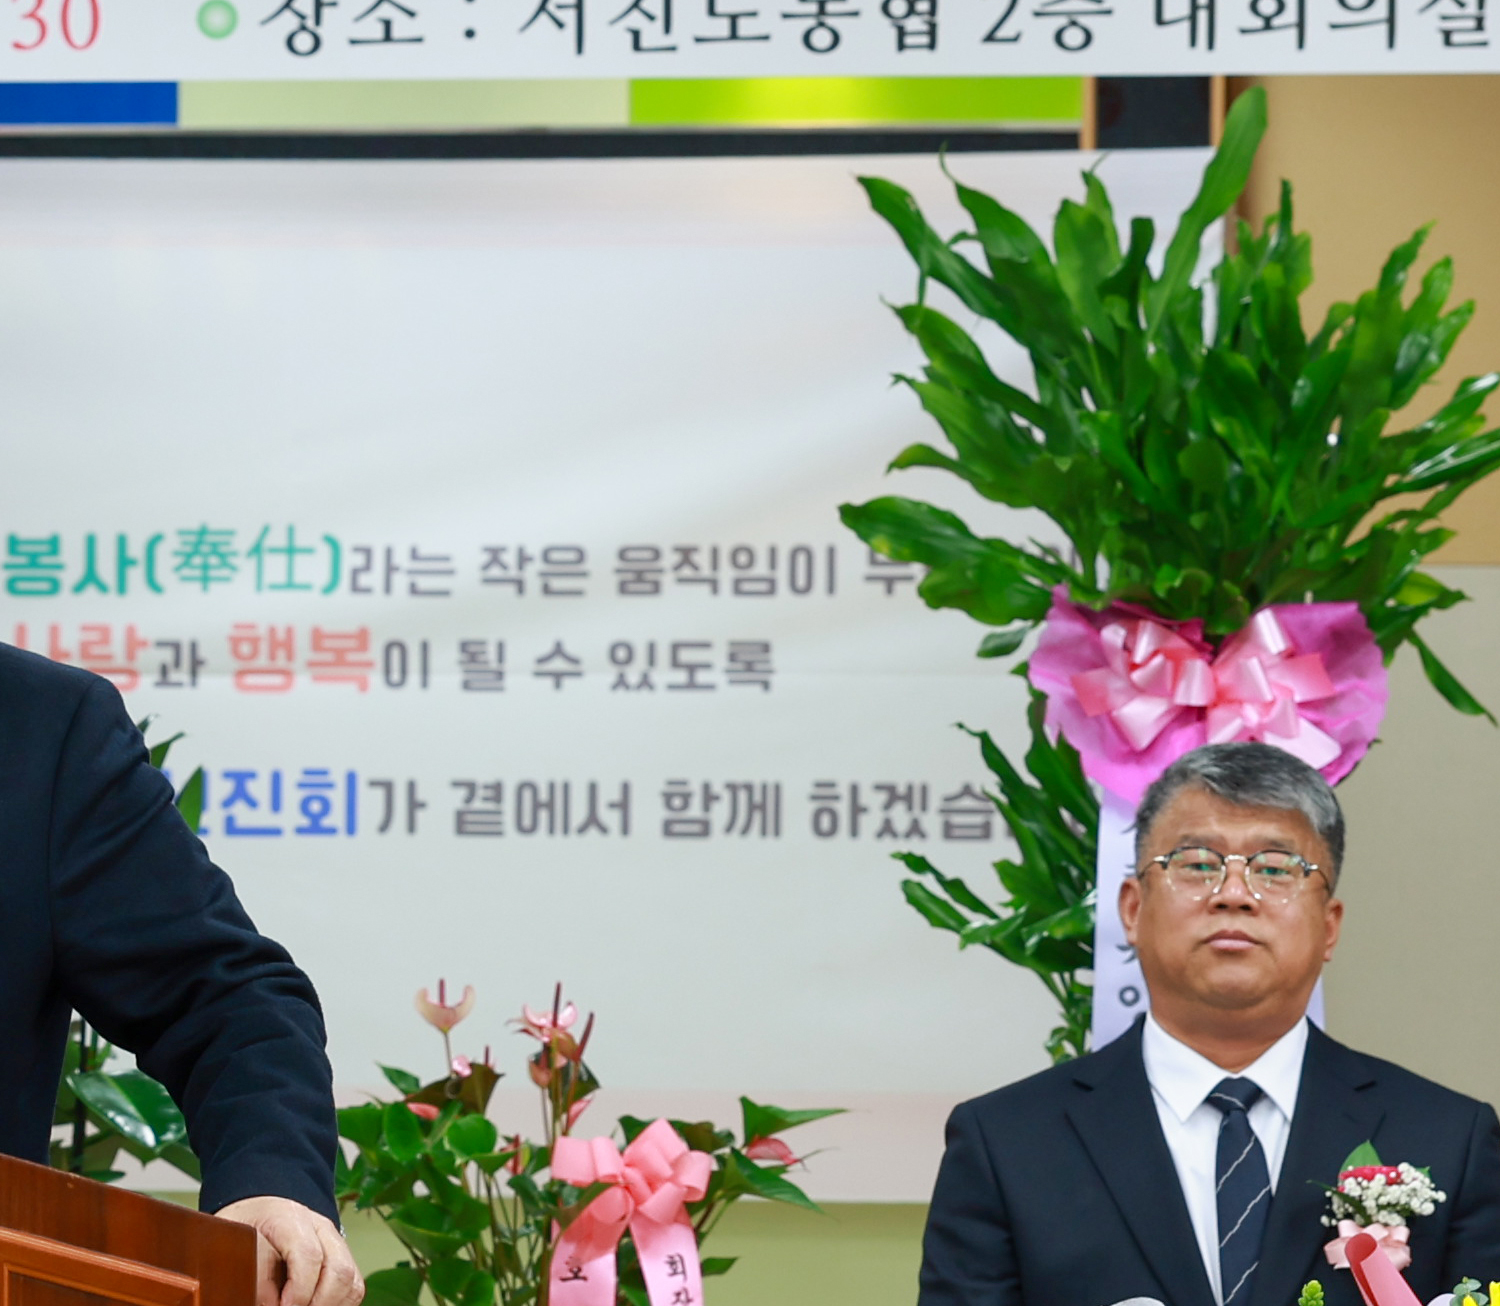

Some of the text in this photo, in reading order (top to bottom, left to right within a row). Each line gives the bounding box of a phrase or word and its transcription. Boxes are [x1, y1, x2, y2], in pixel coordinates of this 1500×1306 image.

[480, 544, 590, 598] 작은
[613, 543, 837, 597] 움직임이
[227, 623, 430, 692] 행복이
[457, 639, 506, 692] 될
[532, 640, 585, 691] 수
[608, 640, 776, 692] 있도록
[450, 779, 632, 839] 곁에서
[660, 778, 783, 840] 함께
